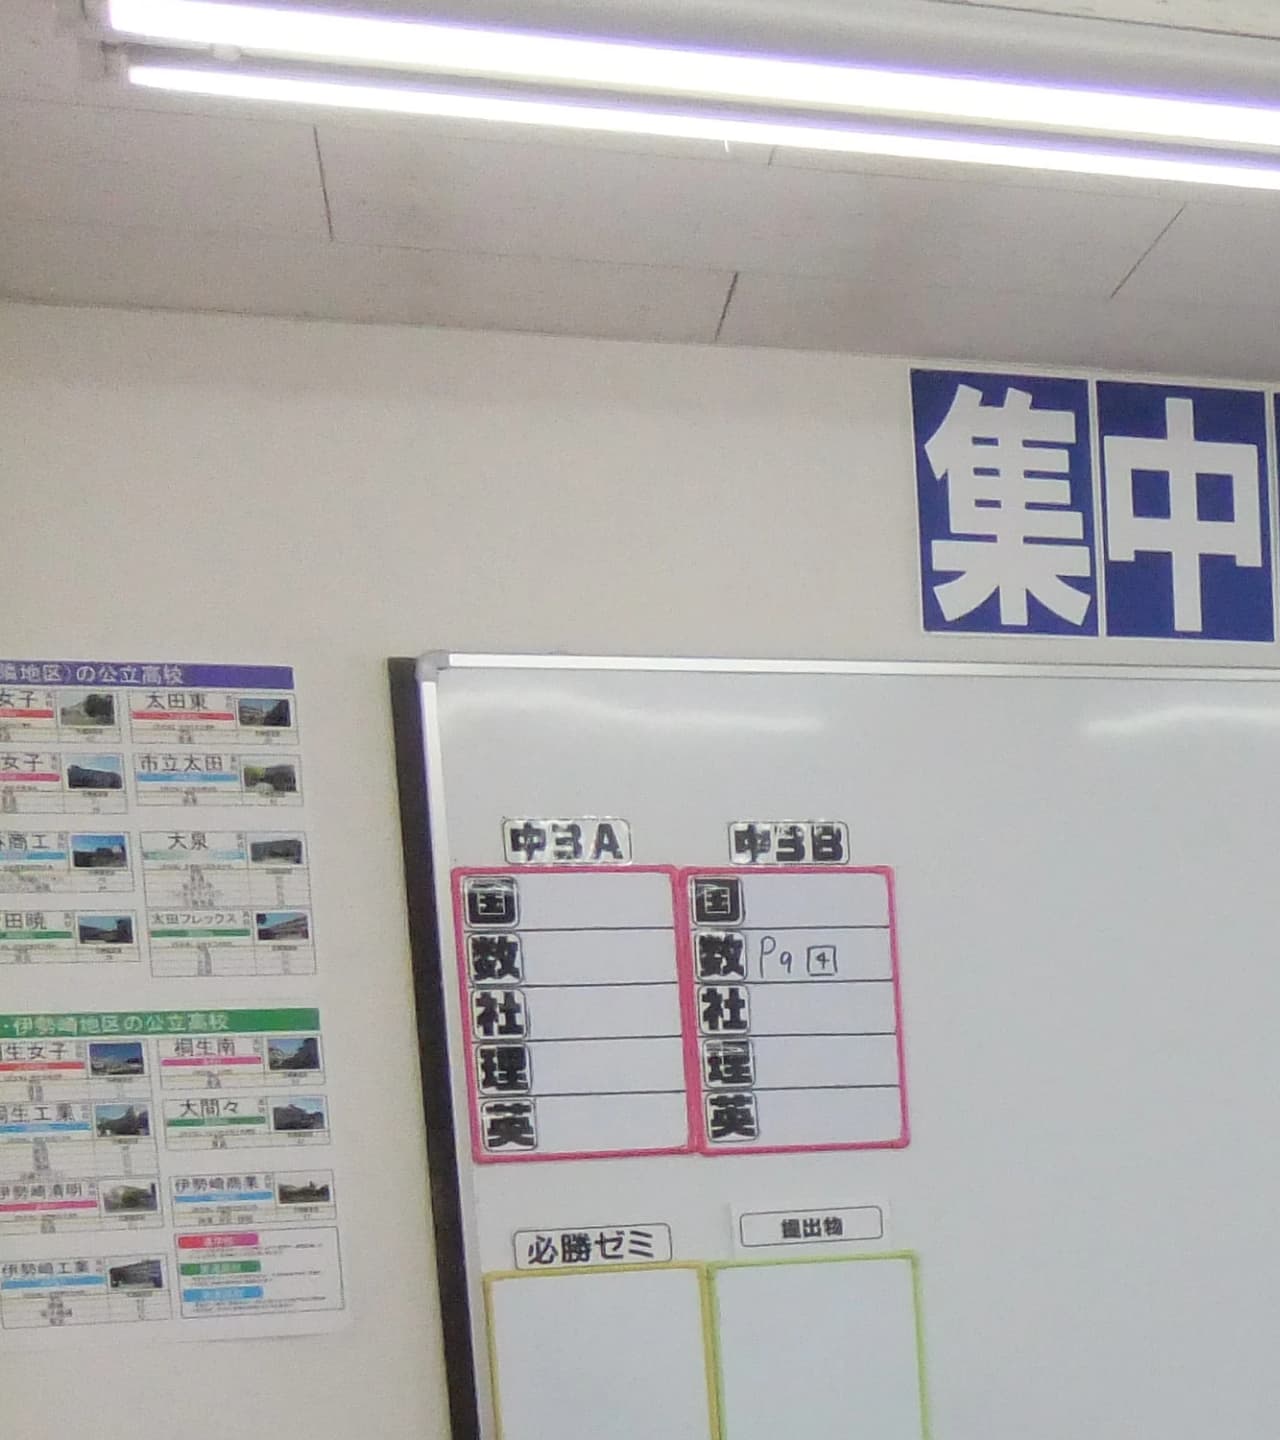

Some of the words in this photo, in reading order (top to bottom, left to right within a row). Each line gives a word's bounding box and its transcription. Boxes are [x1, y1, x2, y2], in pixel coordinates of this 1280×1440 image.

[921, 385, 1263, 632] 集中
[145, 692, 209, 710] 太田東
[139, 755, 223, 772] 市立太田
[167, 832, 209, 850] 大泉
[510, 822, 623, 861] 中3A
[734, 824, 844, 863] 中3B
[151, 911, 238, 926] 太田フレックス
[468, 878, 516, 925] 国
[695, 877, 742, 924] 国
[472, 935, 521, 980] 数
[699, 934, 745, 977] 数
[476, 991, 525, 1035] 社
[702, 986, 748, 1030] 社
[0, 1040, 69, 1061] 生女子
[480, 1046, 529, 1092] 理
[706, 1040, 753, 1084] 理
[179, 1098, 240, 1118] 大間々
[486, 1102, 536, 1148] 英
[710, 1094, 758, 1138] 英
[528, 1229, 654, 1266] 必勝ゼミ
